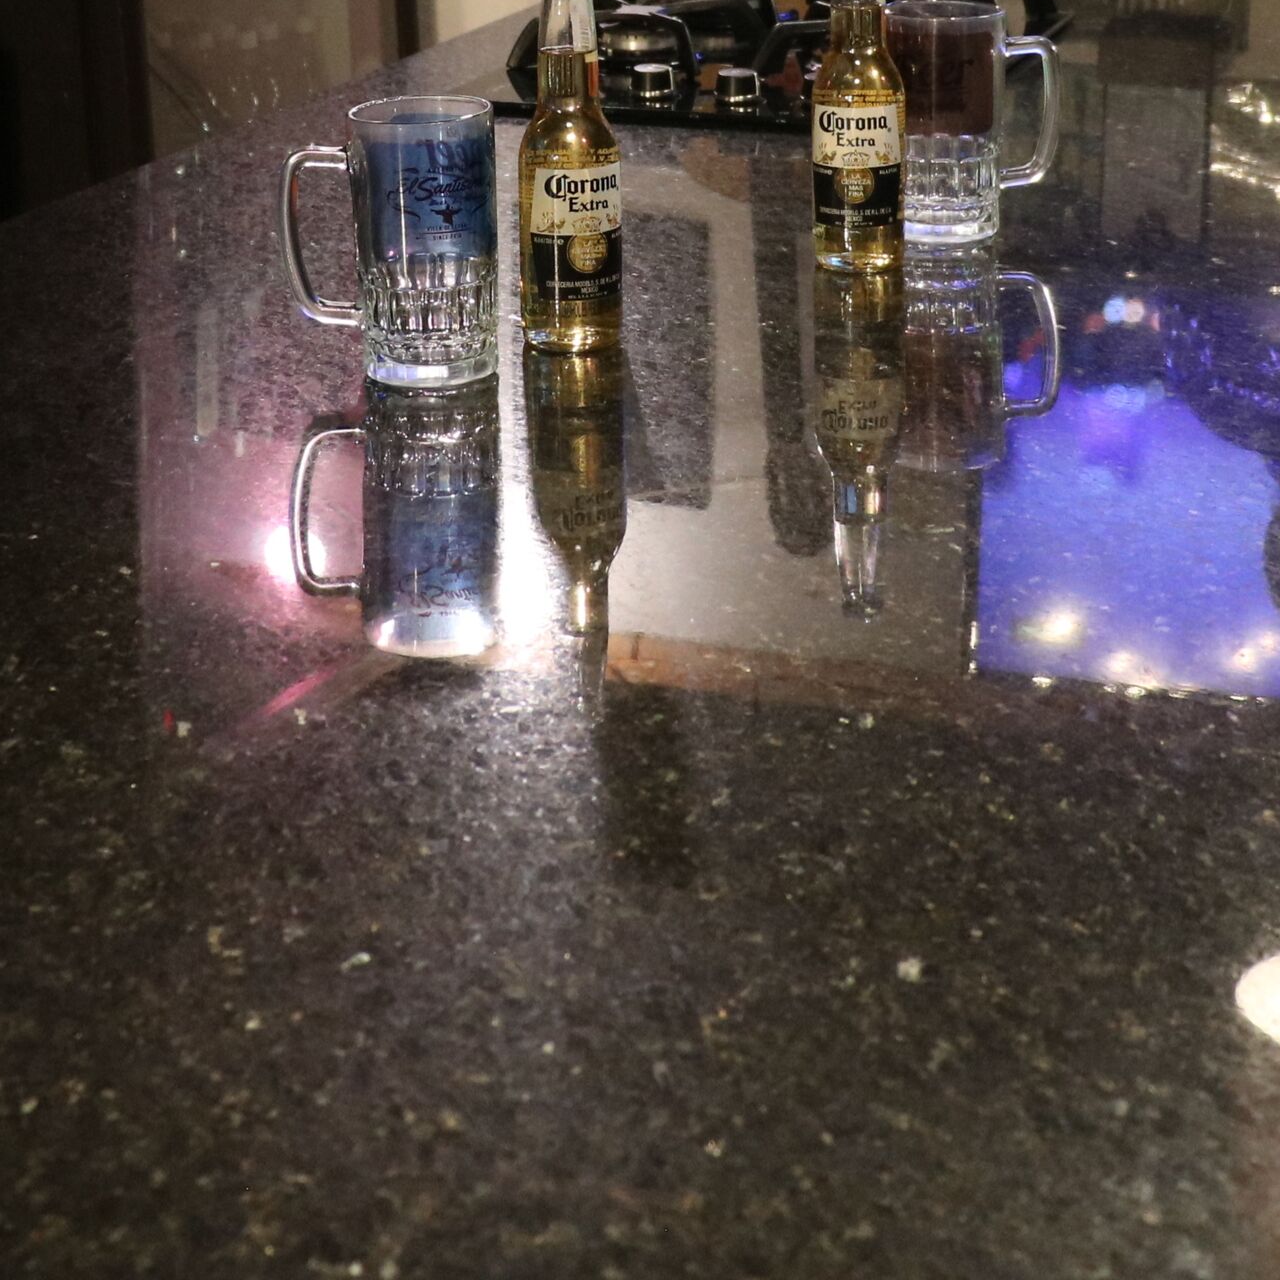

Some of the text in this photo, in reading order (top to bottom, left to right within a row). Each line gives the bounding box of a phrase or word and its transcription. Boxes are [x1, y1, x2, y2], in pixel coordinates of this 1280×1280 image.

[819, 110, 889, 136] Corona
[836, 131, 876, 148] Extra
[543, 173, 618, 202] Corona
[568, 196, 609, 212] Extra
